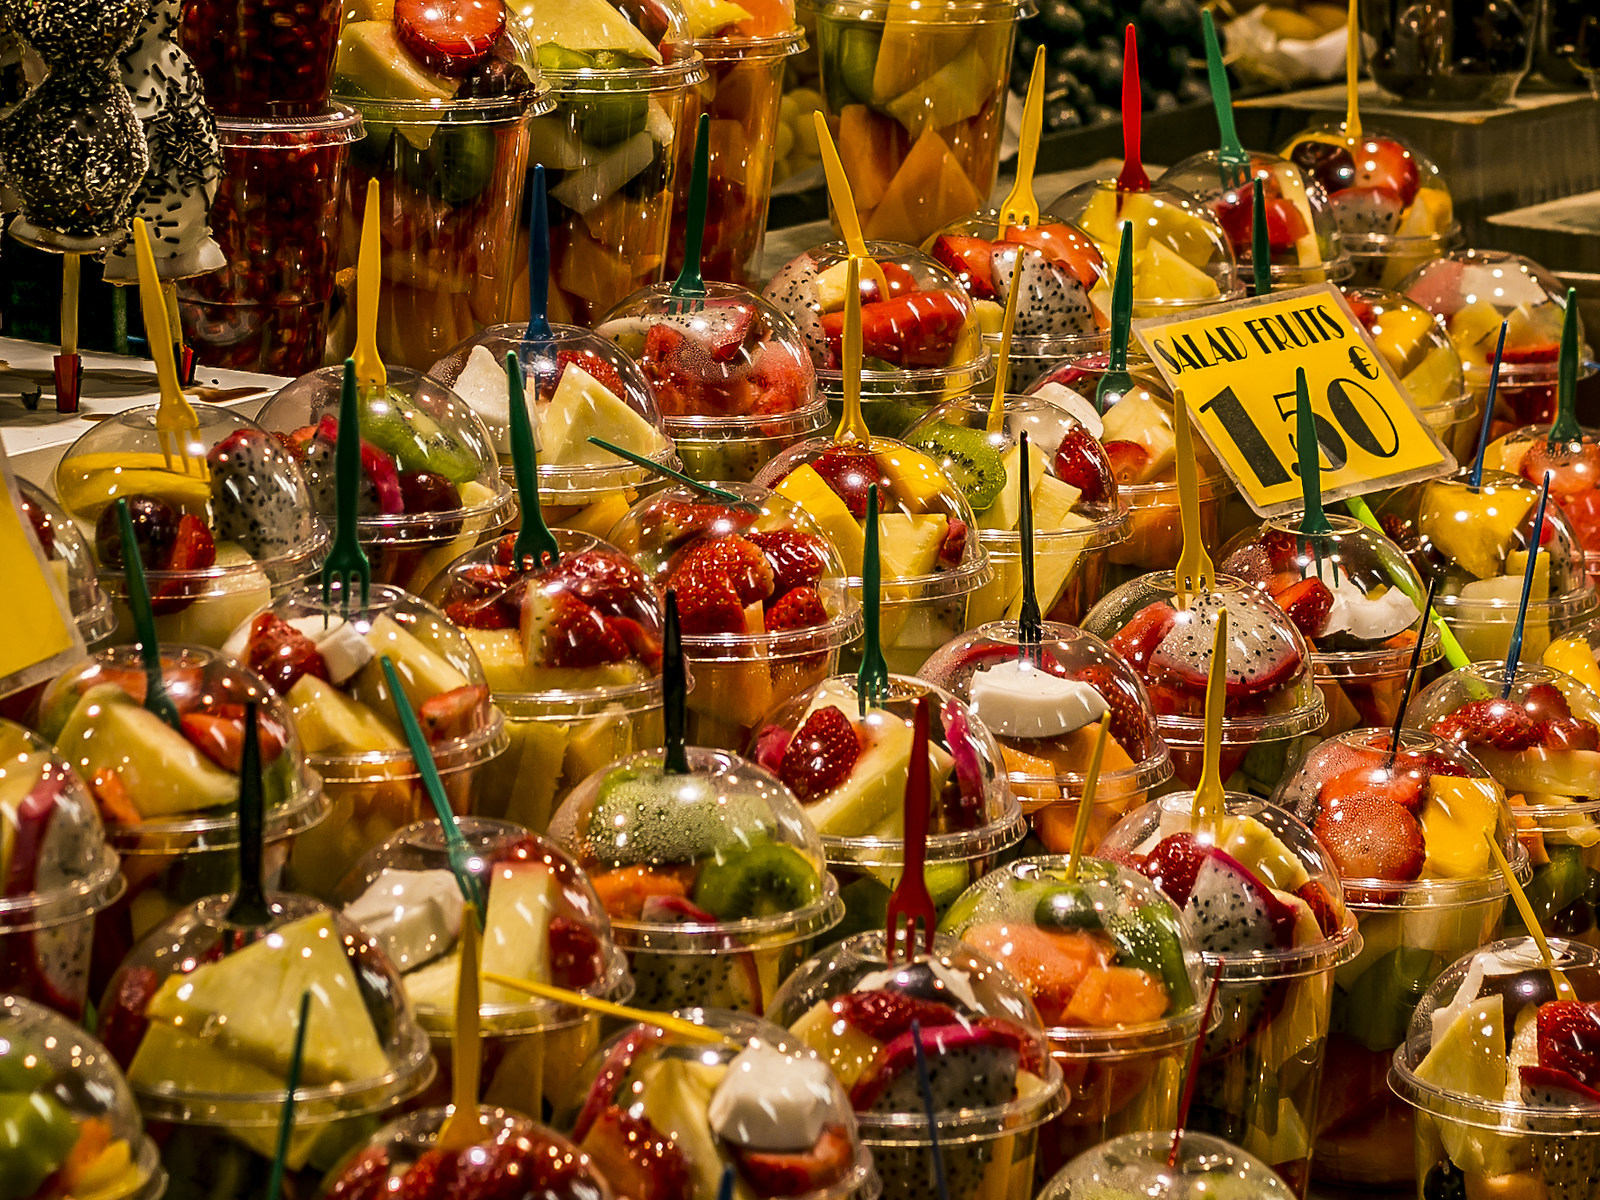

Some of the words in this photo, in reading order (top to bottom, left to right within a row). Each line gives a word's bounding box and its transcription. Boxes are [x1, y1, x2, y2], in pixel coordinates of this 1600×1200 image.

[1153, 326, 1248, 375] SALAD
[1243, 304, 1345, 355] FRUITS
[1348, 345, 1379, 381] €
